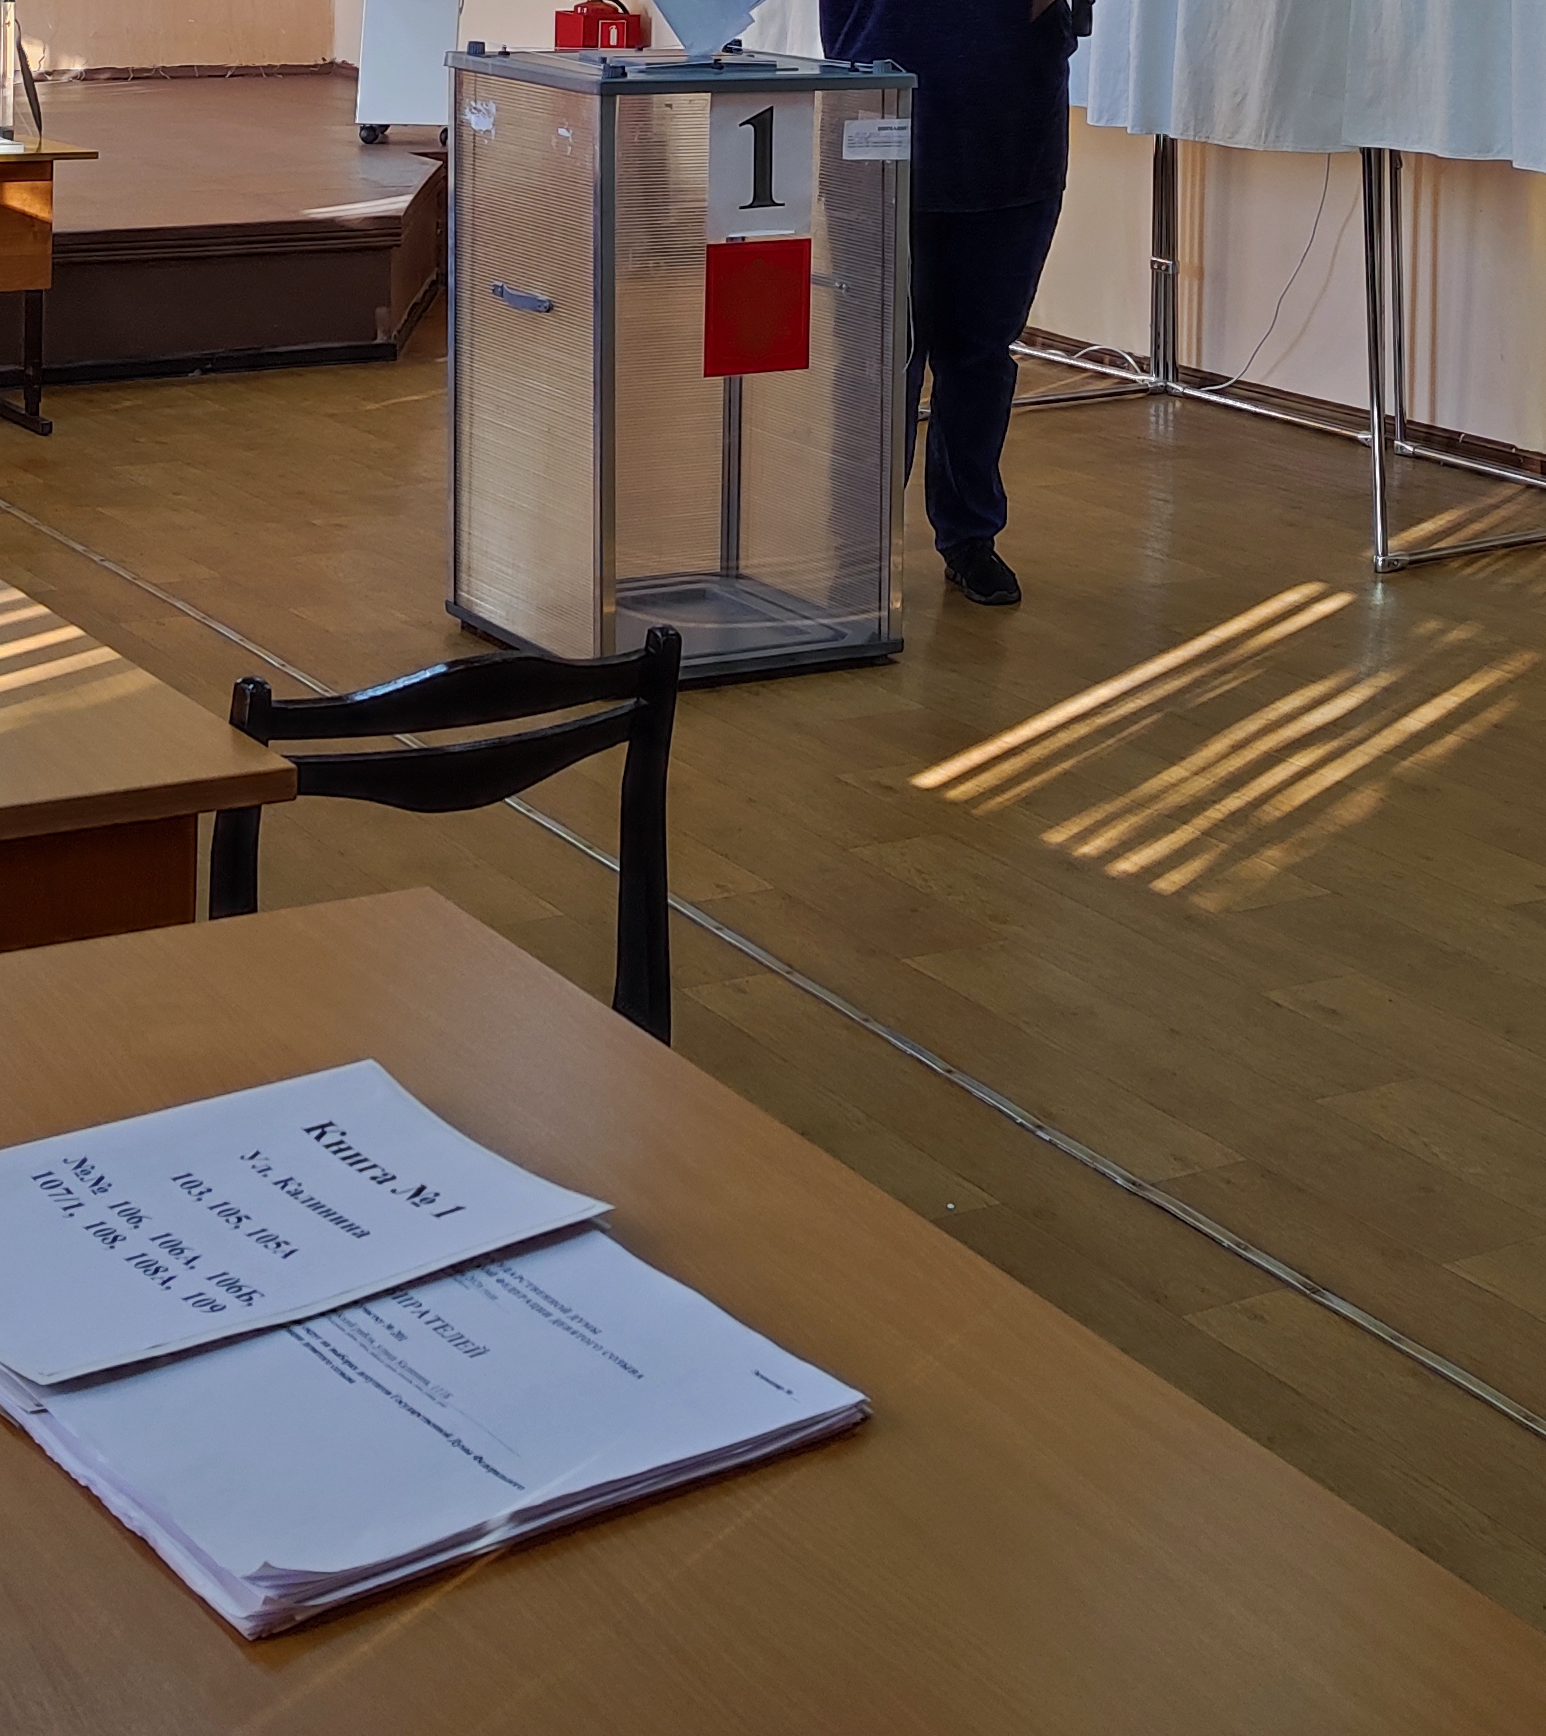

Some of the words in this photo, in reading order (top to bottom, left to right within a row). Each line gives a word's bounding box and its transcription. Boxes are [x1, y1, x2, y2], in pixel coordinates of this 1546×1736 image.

[738, 105, 786, 210] 1
[169, 1171, 214, 1203] 103,
[206, 1199, 252, 1231] 105,
[244, 1226, 299, 1260] 105А
[238, 1148, 273, 1179] Ул.
[271, 1175, 371, 1240] Калинина
[302, 1119, 397, 1186] Книга
[388, 1182, 441, 1209] №
[431, 1204, 467, 1219] 1
[29, 1169, 85, 1218] 107/1,
[82, 1219, 128, 1251] 108,
[123, 1251, 178, 1291] 108А,
[179, 1290, 228, 1314] 109
[61, 1155, 113, 1197] №№
[106, 1199, 148, 1231] 106,
[147, 1231, 202, 1271] 106А,
[204, 1270, 265, 1308] 106Б,
[389, 1292, 489, 1358] ИРАТЕЛЕЙ
